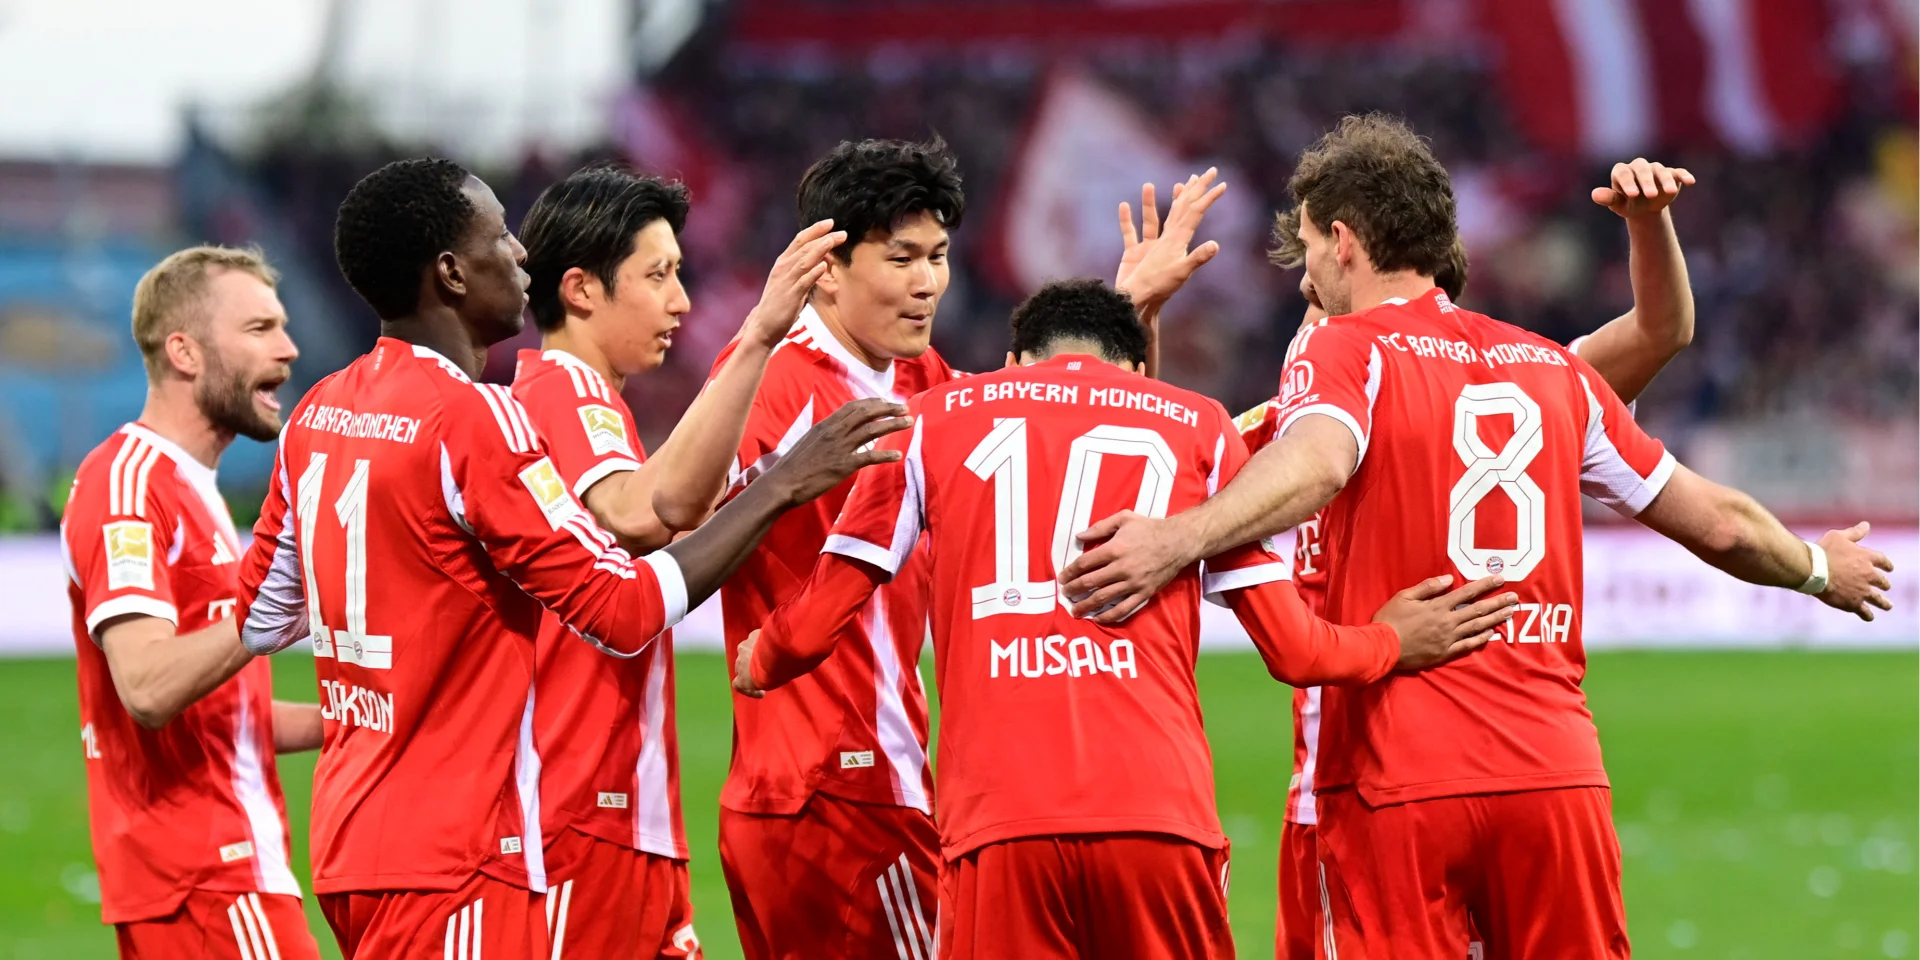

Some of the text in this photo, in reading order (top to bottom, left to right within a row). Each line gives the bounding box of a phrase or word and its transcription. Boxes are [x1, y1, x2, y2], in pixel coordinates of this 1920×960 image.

[945, 381, 1199, 428] FC BAYERN MÜNCHEN
[1377, 332, 1408, 352] FC
[1480, 343, 1568, 369] MÜNCHEN
[963, 417, 1178, 623] 10
[1447, 382, 1546, 582] 8
[296, 452, 393, 670] 11
[990, 634, 1139, 679] MUSALA
